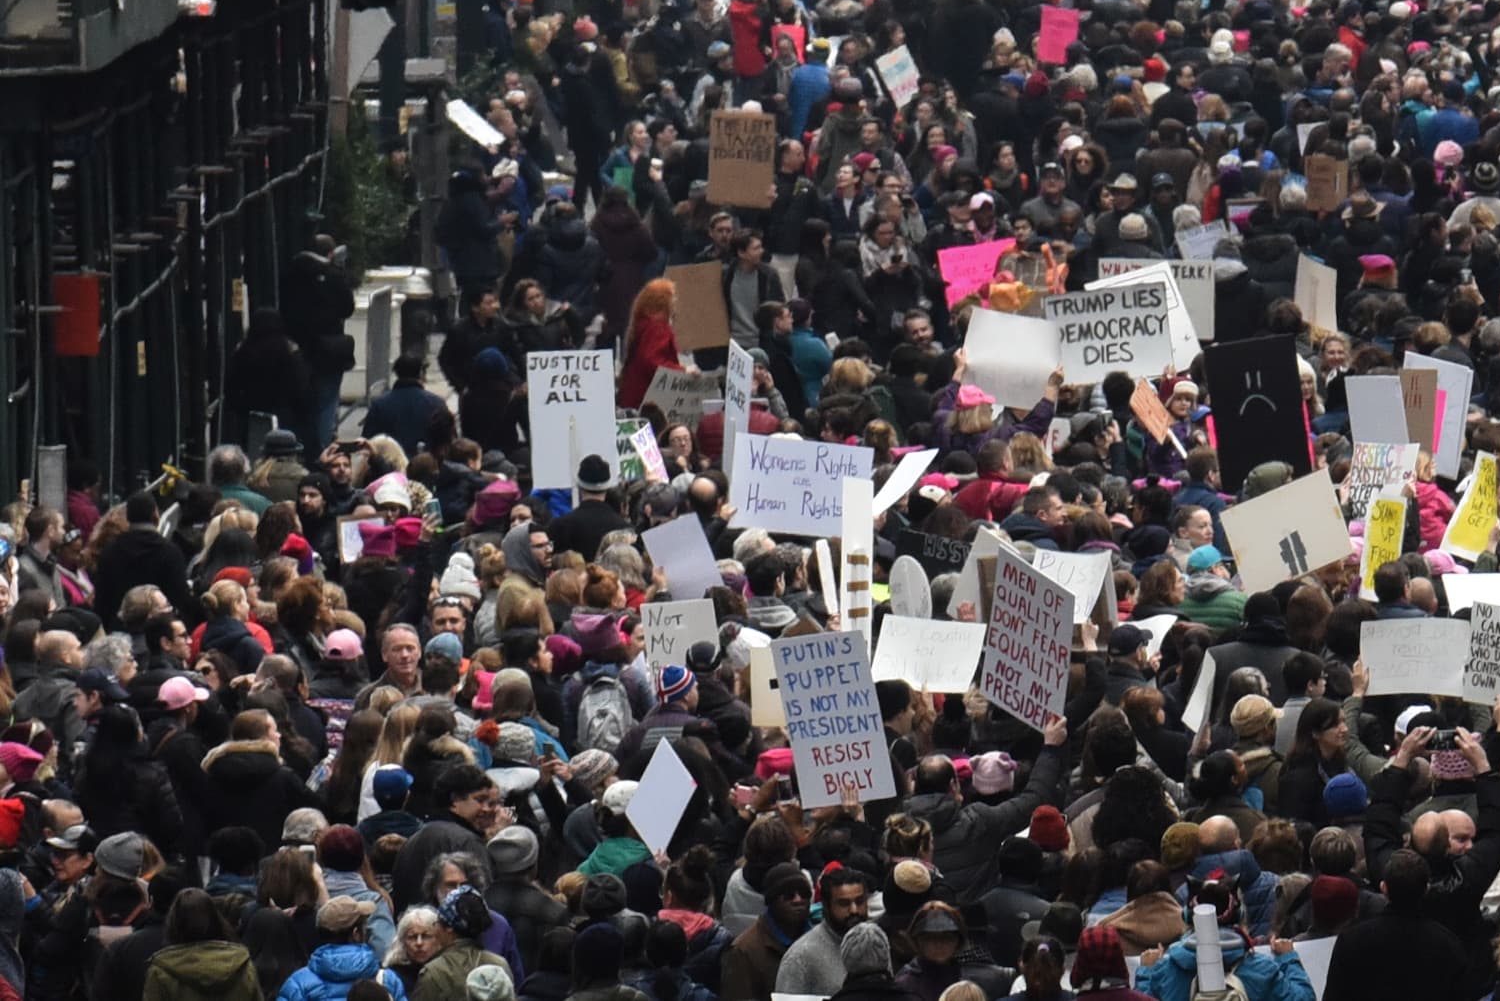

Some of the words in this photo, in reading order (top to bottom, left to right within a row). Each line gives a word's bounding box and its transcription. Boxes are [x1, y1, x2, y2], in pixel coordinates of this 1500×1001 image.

[1048, 294, 1115, 317] TRUMP
[1121, 287, 1162, 310] LIES
[529, 355, 600, 372] JUSTICE
[1083, 341, 1134, 367] DIES
[551, 373, 582, 389] FOR
[545, 391, 587, 405] ALL
[750, 439, 806, 474] Womens
[815, 445, 859, 483] Rights
[746, 484, 787, 514] Human
[801, 490, 843, 520] Rights
[1002, 562, 1036, 593] MEN
[1043, 587, 1065, 610] OF
[996, 584, 1062, 636] QUALITY
[1476, 603, 1493, 618] NO
[992, 605, 1027, 638] DONT
[1033, 630, 1069, 669] FEAR
[782, 641, 853, 666] PUTIN'S
[988, 627, 1064, 689] EQUALITY
[1471, 645, 1493, 659] WHO
[785, 661, 860, 692] PUPPET
[996, 660, 1023, 688] NOT
[1030, 679, 1052, 706] MY
[1471, 673, 1496, 689] OWN
[786, 699, 803, 717] IS
[811, 694, 838, 712] NOT
[847, 689, 871, 708] MY
[985, 677, 1061, 733] PRESIDENT
[788, 712, 879, 739] PRESIDENT
[811, 741, 871, 767] RESIST
[823, 768, 873, 796] BIGLY
